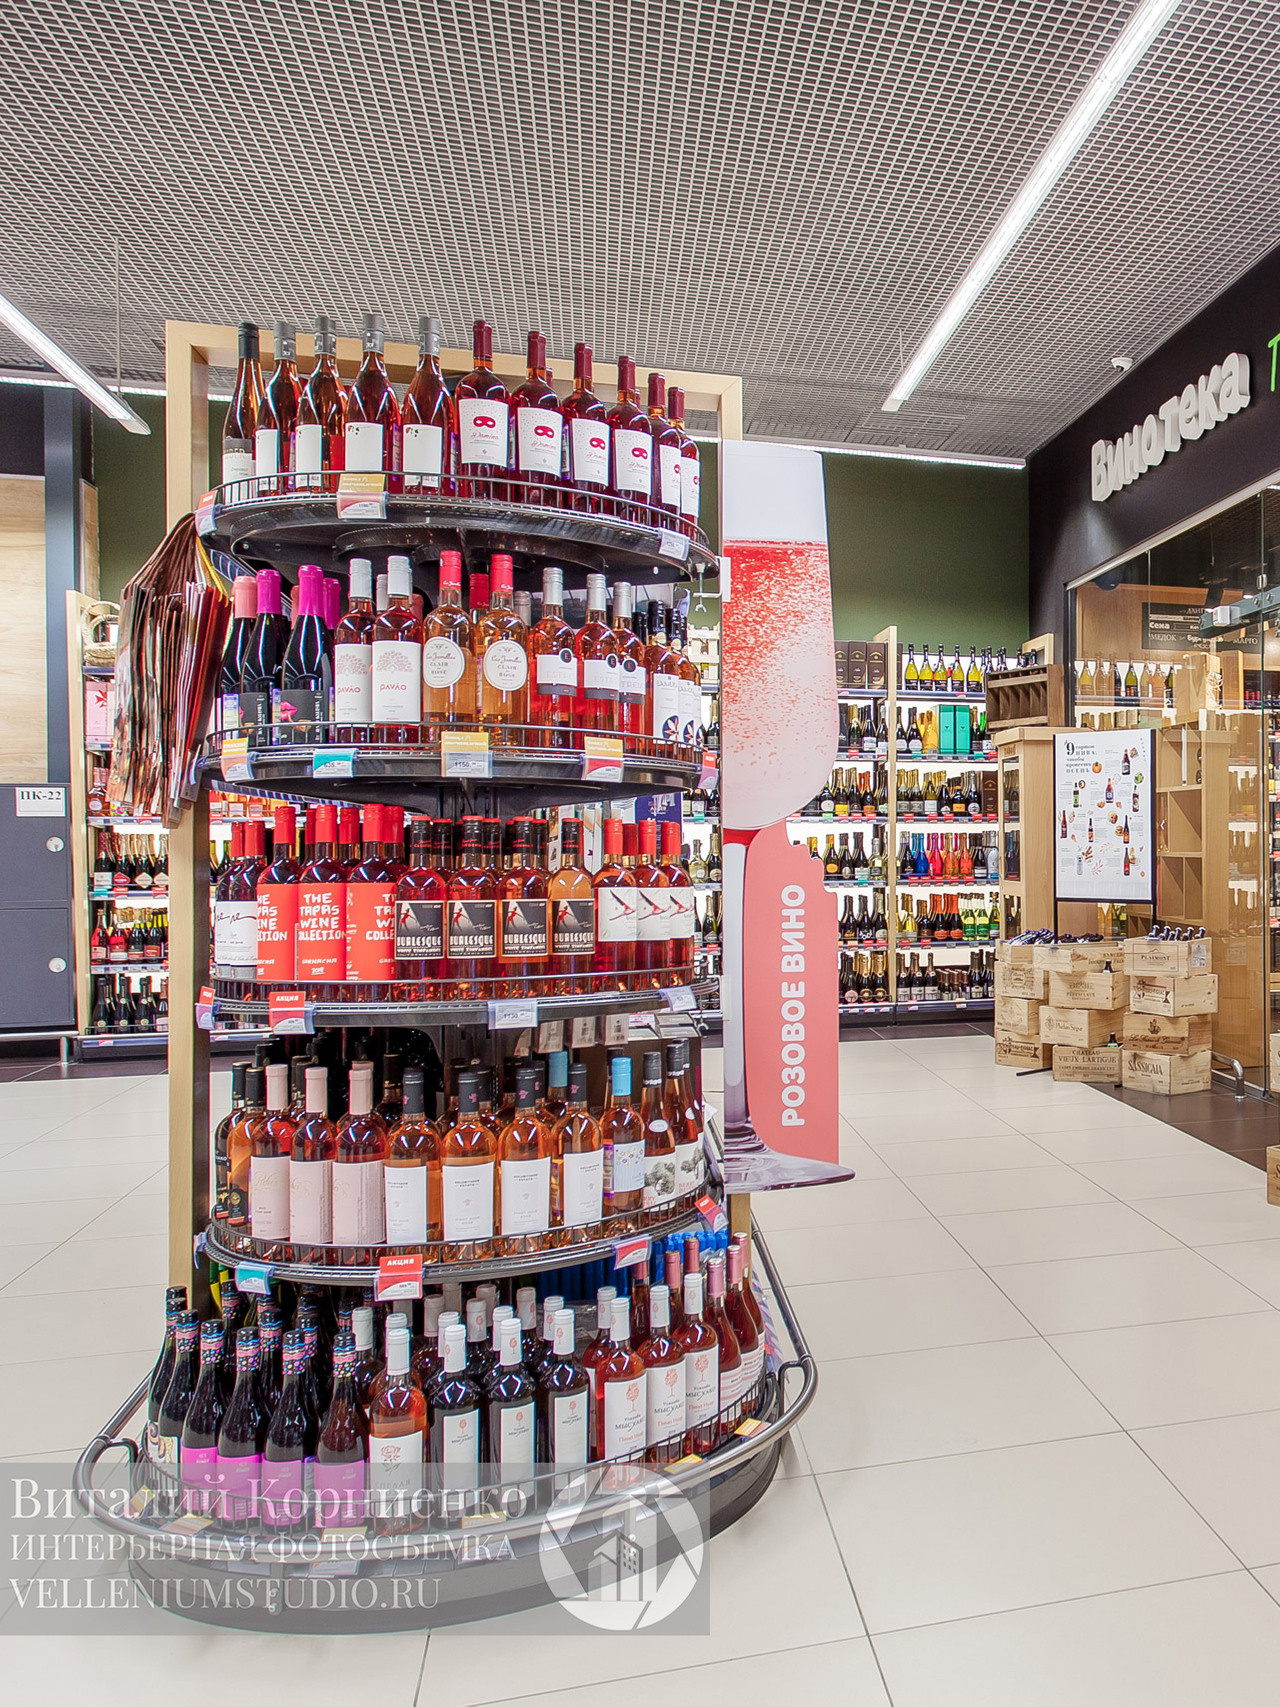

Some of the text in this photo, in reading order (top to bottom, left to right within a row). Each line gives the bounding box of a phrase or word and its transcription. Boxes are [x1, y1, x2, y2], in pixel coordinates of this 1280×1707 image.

[1091, 351, 1250, 501] Винотека
[1066, 742, 1075, 755] 9
[20, 789, 62, 803] ПК-22
[303, 892, 332, 903] THE
[299, 906, 340, 916] TAPAS
[300, 917, 339, 929] WINE
[397, 936, 442, 948] BURLESQUE
[450, 935, 493, 946] BURLESQUE
[504, 934, 546, 945] BURLESQUE
[555, 933, 593, 944] BURLESQUE
[1140, 954, 1171, 962] PLAIMONT
[781, 884, 806, 1127] РОЗОВОЕ ВИНО
[1082, 1056, 1117, 1064] LARTIGUE
[1128, 1061, 1164, 1076] SASSICAIA
[386, 1258, 415, 1266] АКЦИЯ
